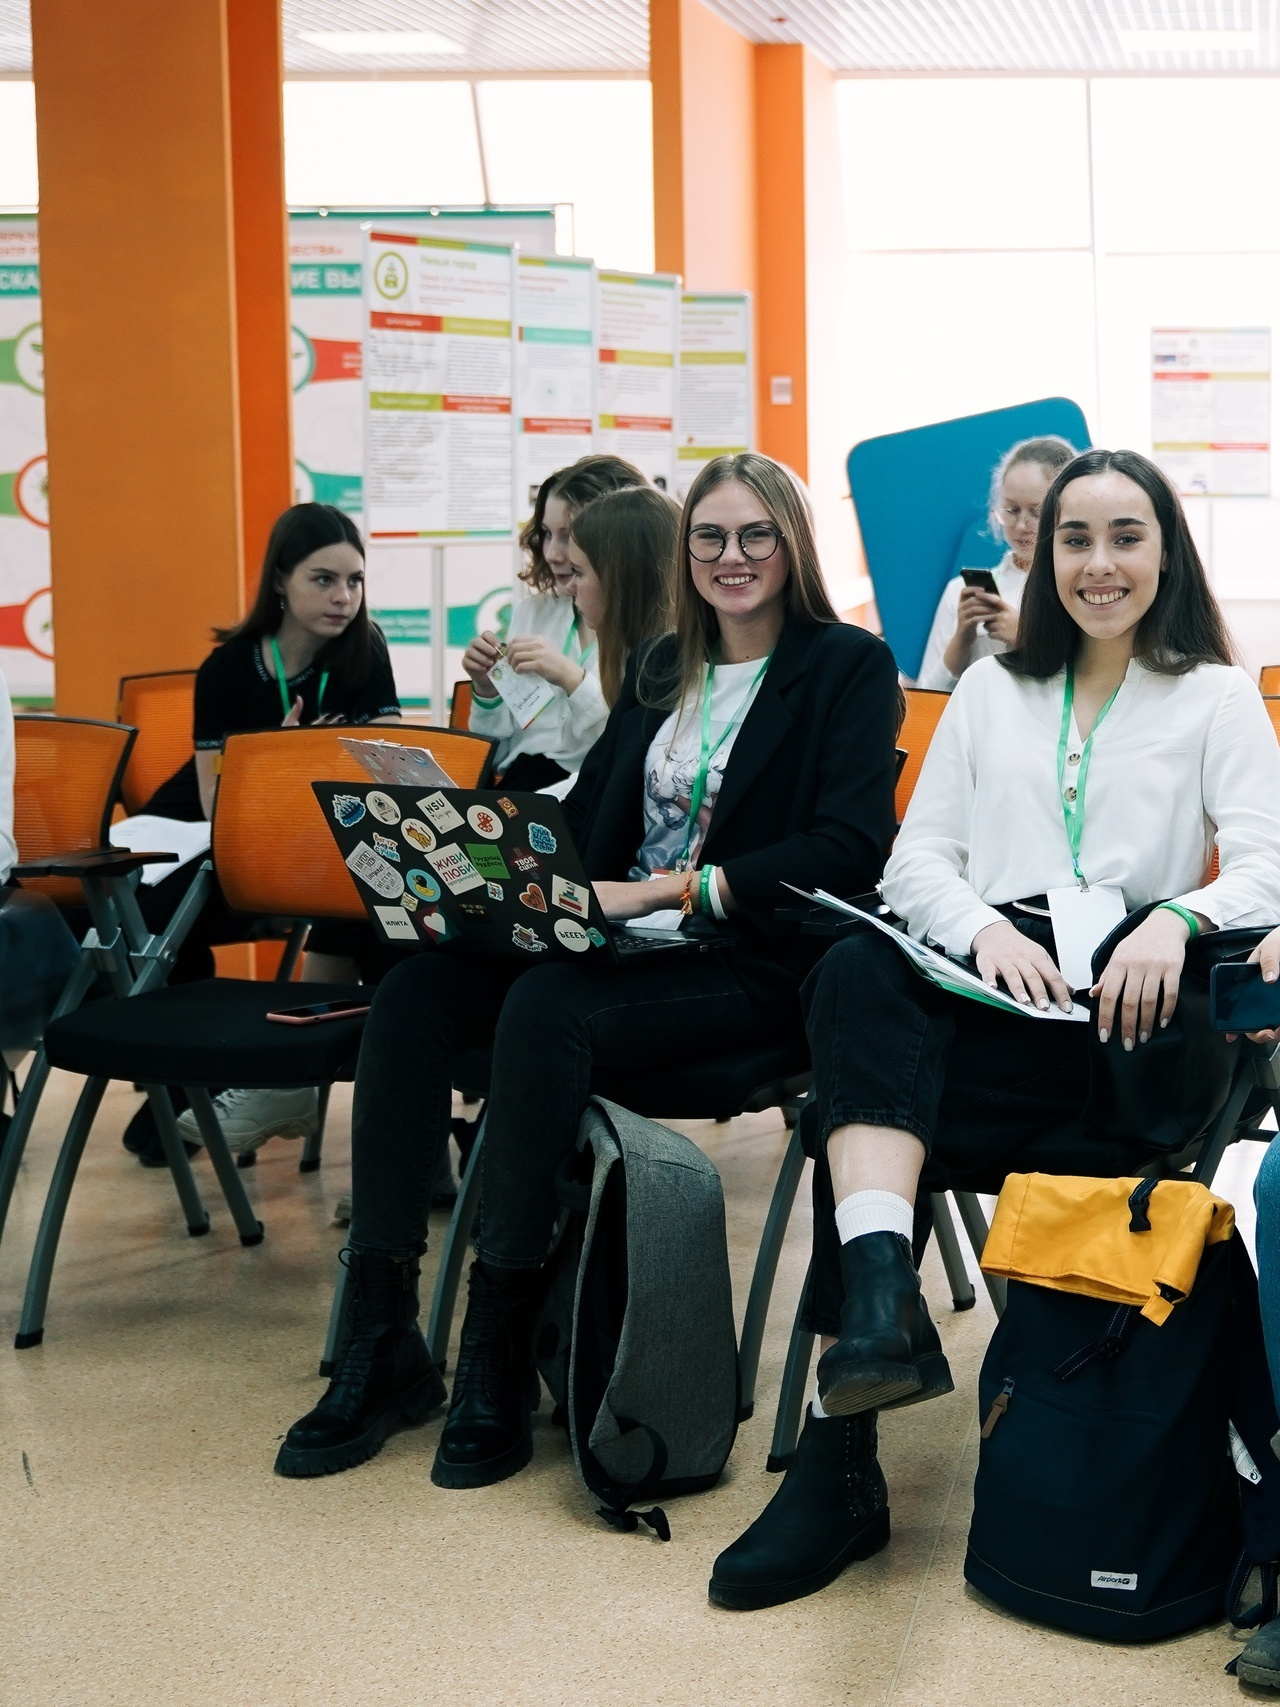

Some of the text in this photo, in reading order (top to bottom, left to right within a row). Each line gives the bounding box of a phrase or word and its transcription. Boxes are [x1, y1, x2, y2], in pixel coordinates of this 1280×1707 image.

[291, 270, 319, 288] ИЕ
[325, 269, 362, 288] ВЫ
[425, 798, 445, 815] NSU
[433, 852, 466, 871] ЖИВИ
[514, 856, 535, 867] ТВОЯ
[518, 862, 538, 872] СЦЕНА
[442, 863, 474, 882] ЛЮБИ
